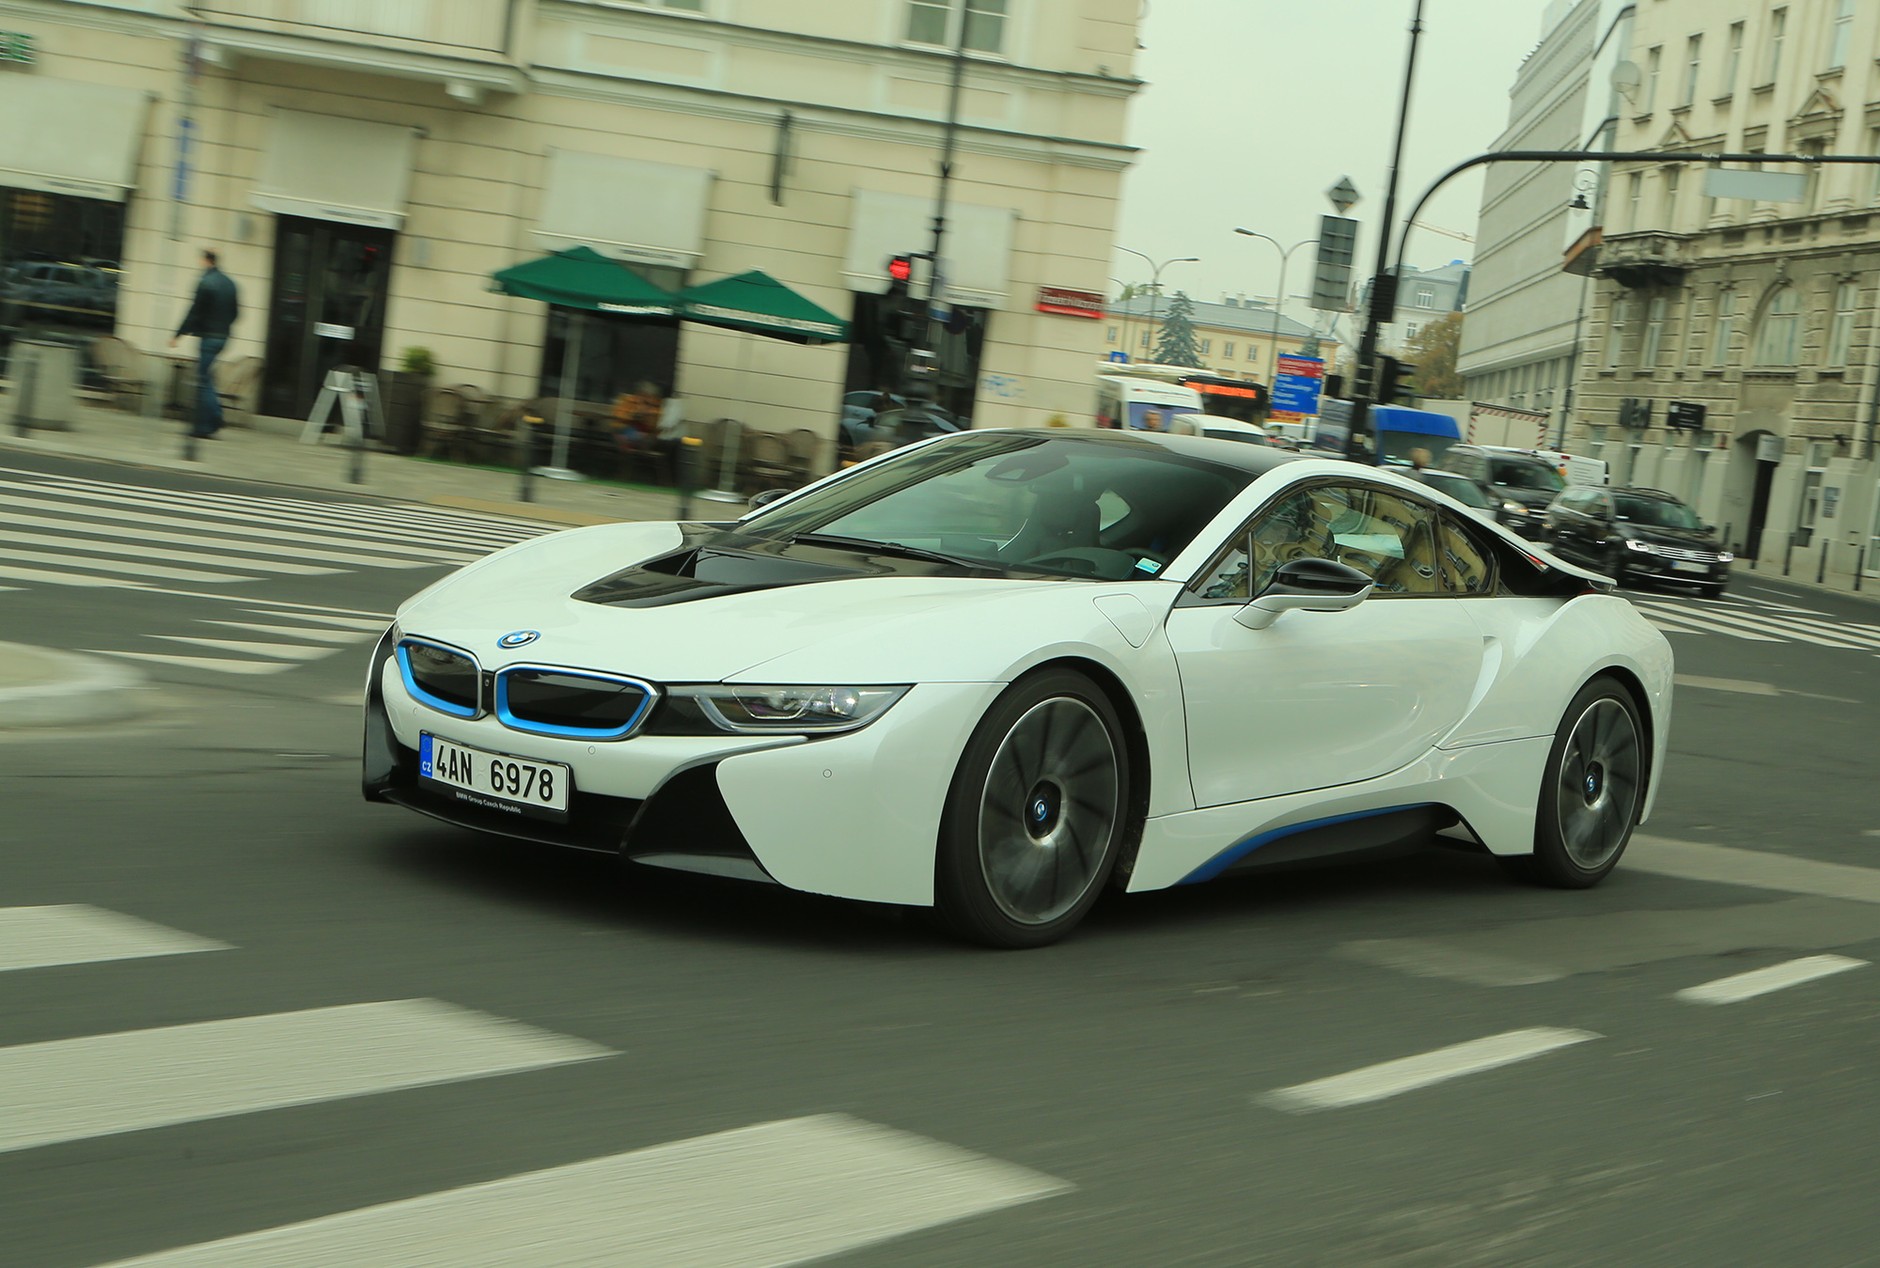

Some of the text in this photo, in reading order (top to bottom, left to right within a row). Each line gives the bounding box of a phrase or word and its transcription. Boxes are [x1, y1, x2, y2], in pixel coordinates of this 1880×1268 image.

[422, 761, 432, 772] CZ
[436, 745, 553, 801] 4AN 6978
[456, 791, 521, 814] BMW Group Czech Republic
